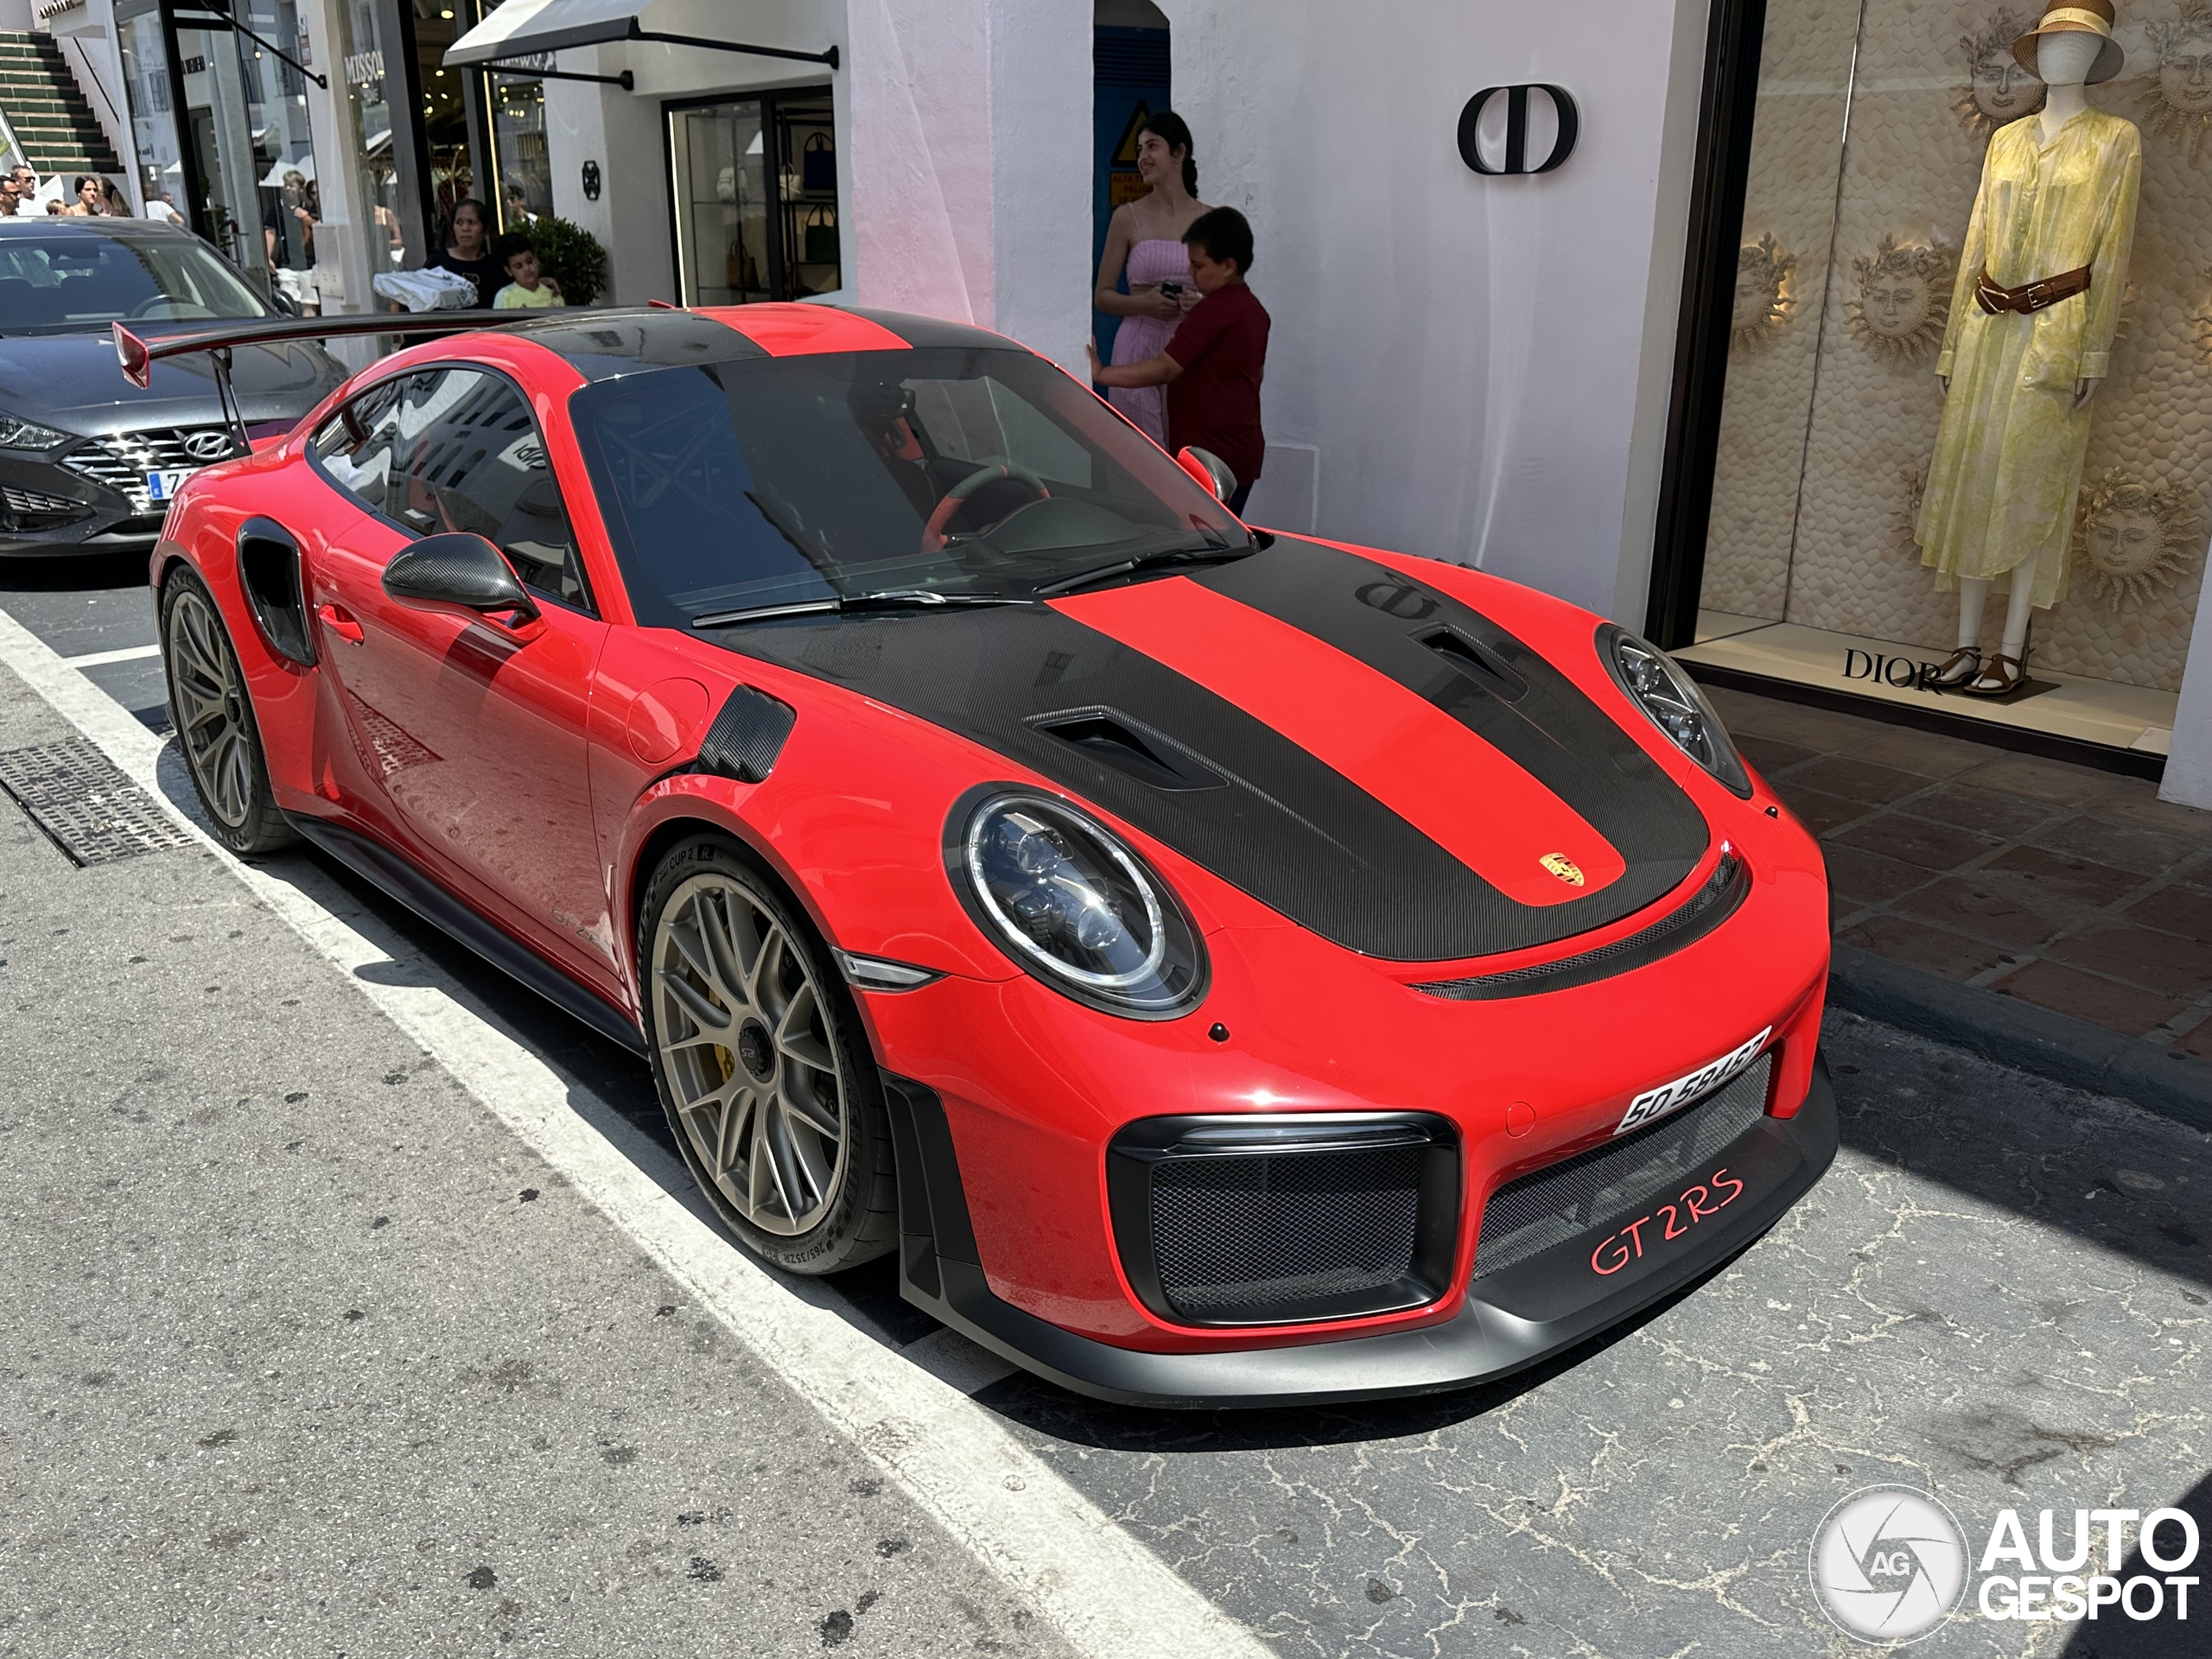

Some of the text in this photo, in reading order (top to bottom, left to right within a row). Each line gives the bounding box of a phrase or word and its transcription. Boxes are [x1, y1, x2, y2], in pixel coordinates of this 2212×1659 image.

[1841, 648, 1943, 696] DIOR
[669, 850, 686, 870] CUP
[688, 848, 693, 861] 2
[741, 1047, 756, 1058] RS
